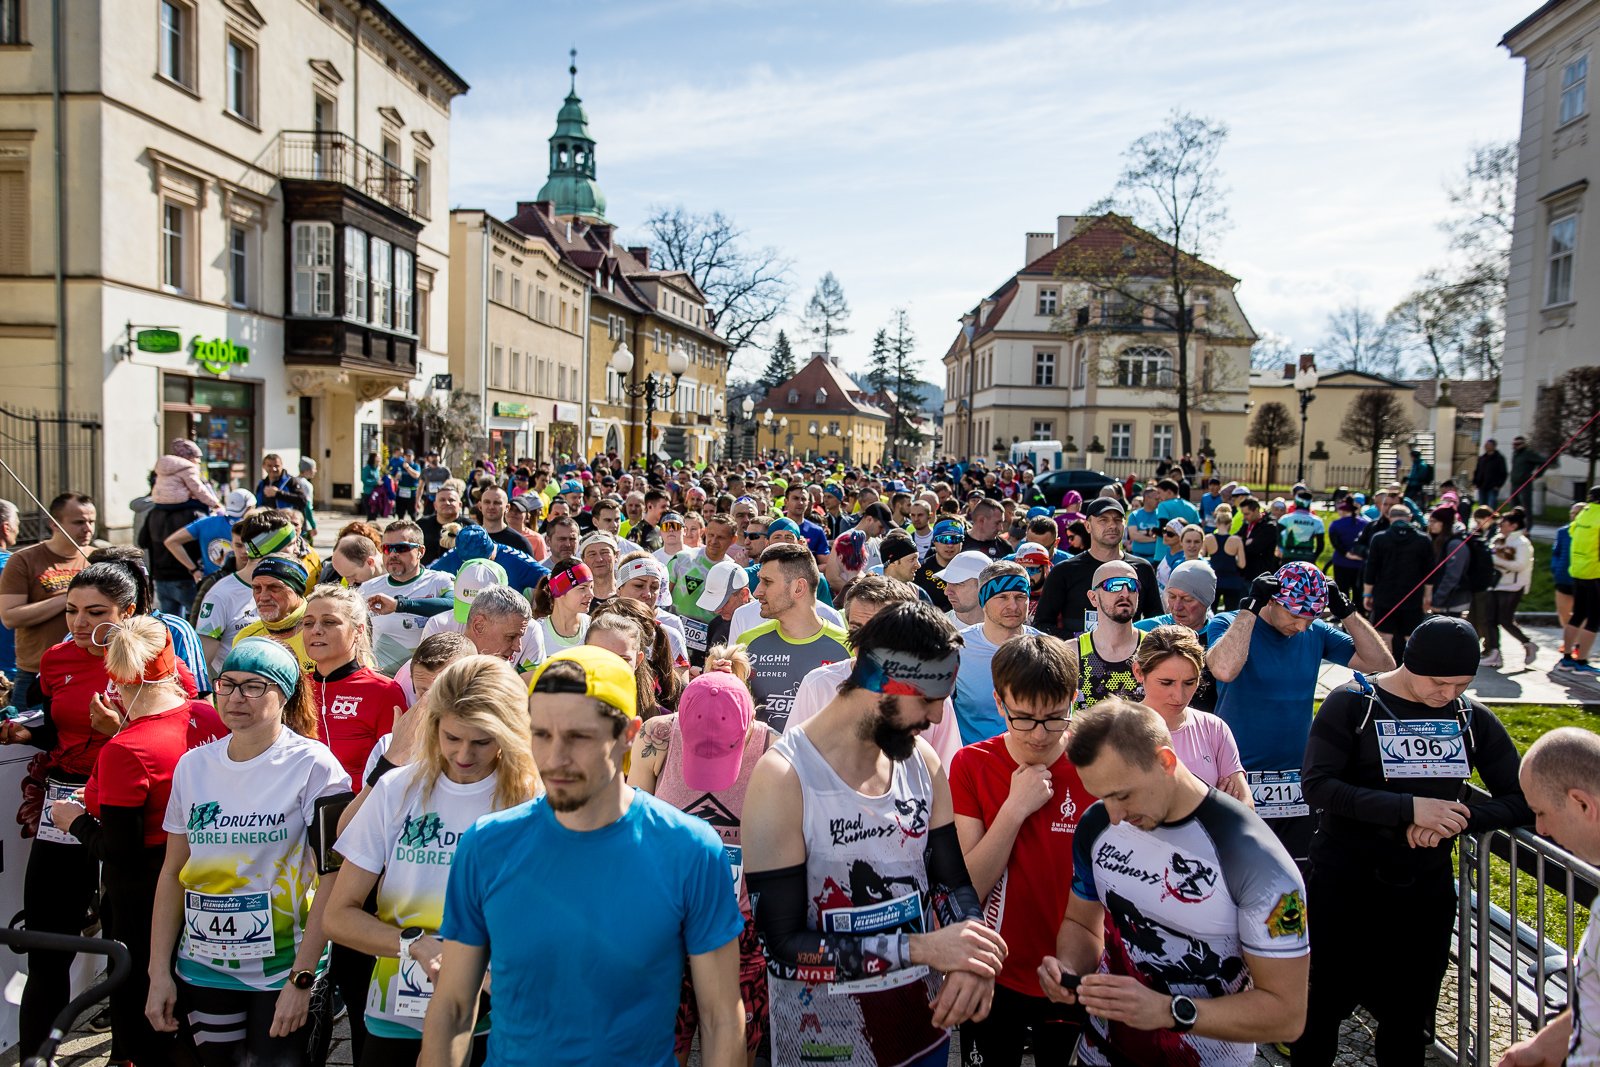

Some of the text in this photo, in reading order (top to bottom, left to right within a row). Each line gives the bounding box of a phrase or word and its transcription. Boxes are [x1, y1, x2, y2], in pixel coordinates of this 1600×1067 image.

[685, 627, 702, 640] 306
[1400, 739, 1442, 757] 196
[1263, 785, 1292, 801] 211
[219, 812, 285, 828] DRUŻYNA
[187, 828, 288, 844] OBREJ ENERGII
[209, 915, 237, 937] 44
